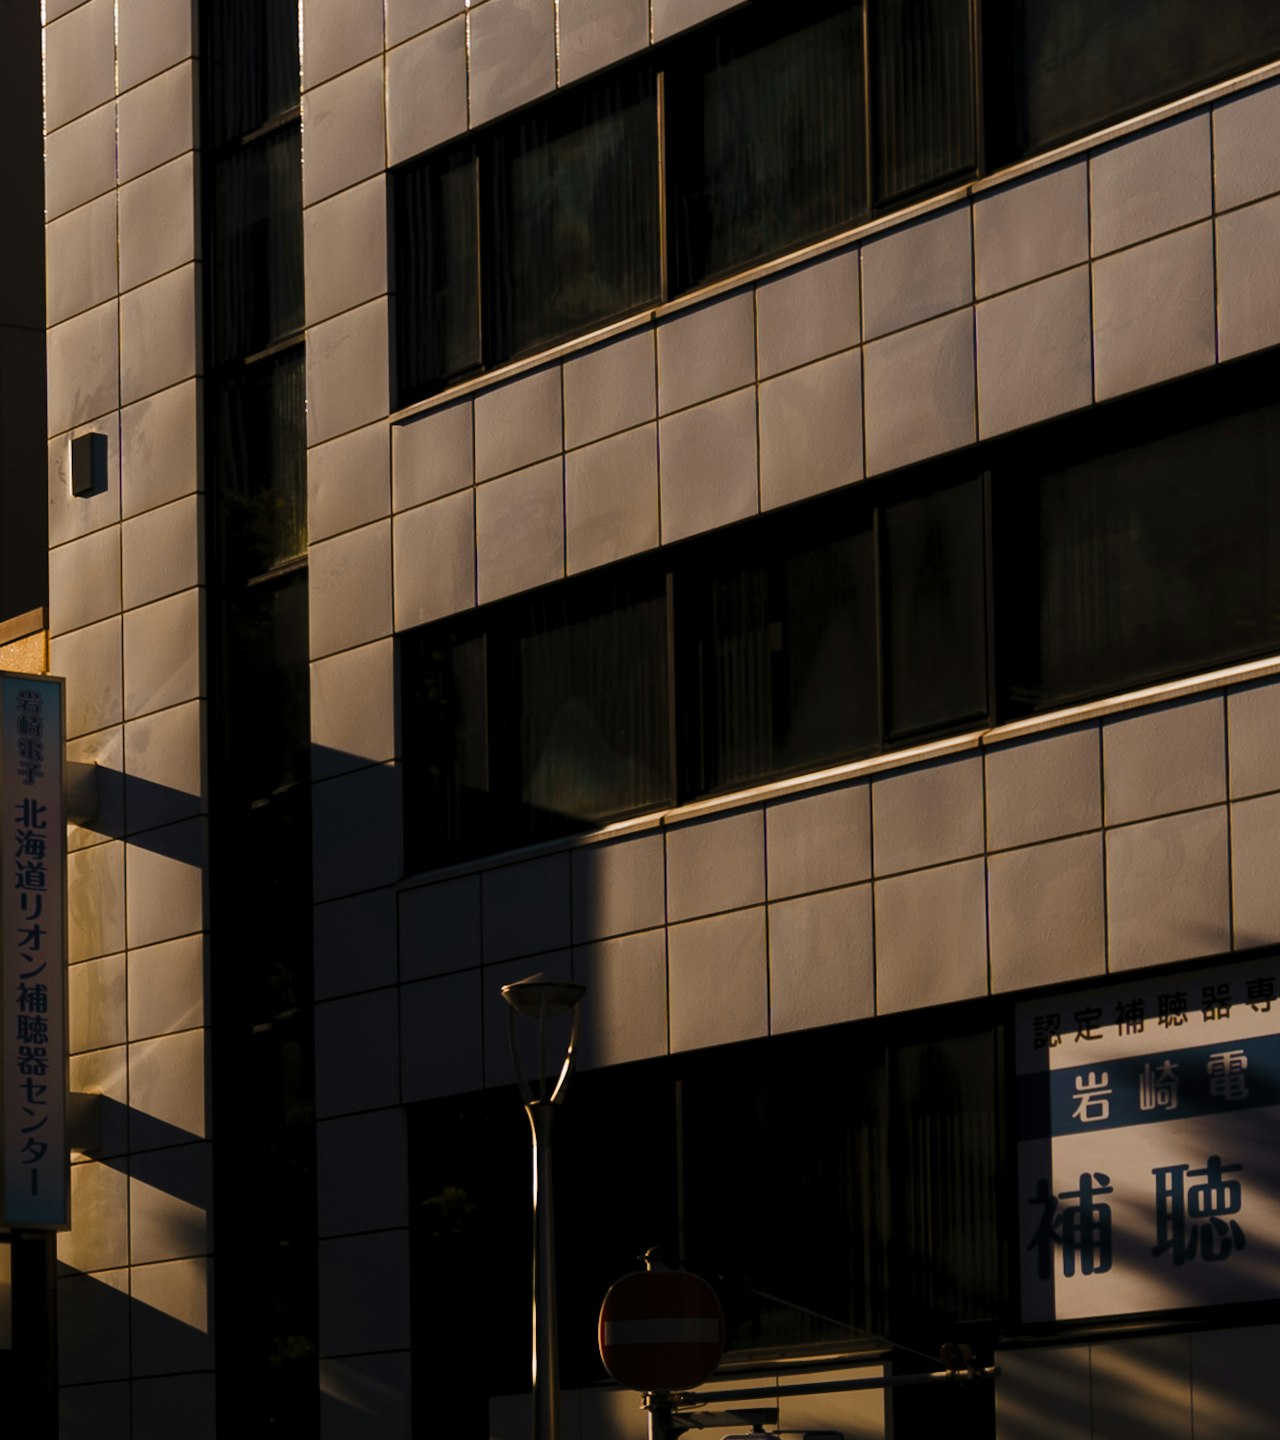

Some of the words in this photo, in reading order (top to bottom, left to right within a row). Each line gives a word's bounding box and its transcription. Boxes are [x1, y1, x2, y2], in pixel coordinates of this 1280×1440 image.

[16, 689, 44, 785] 岩崎電子
[15, 798, 49, 1197] 北海道リオン補聴器センター
[1033, 976, 1277, 1050] 認定補聴器専
[1072, 1049, 1249, 1123] 岩崎電
[1027, 1155, 1246, 1281] 補聴
